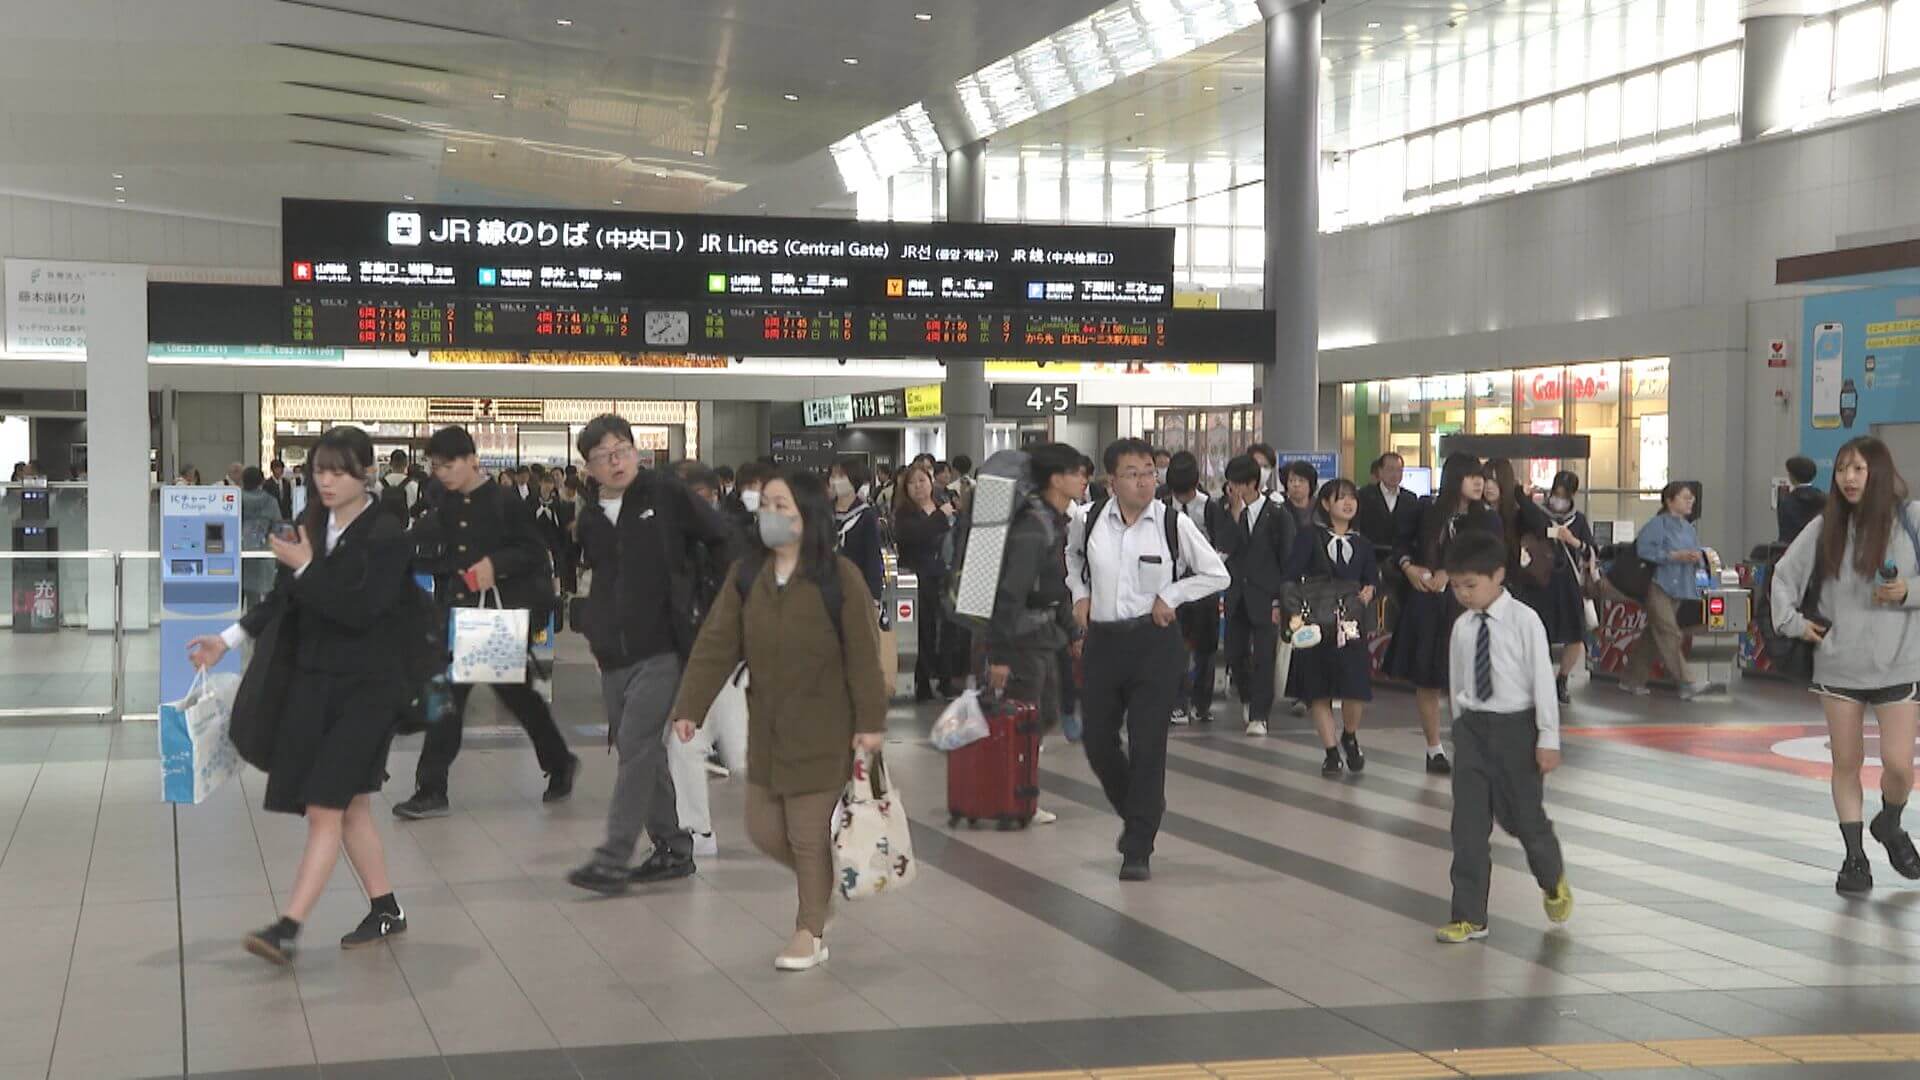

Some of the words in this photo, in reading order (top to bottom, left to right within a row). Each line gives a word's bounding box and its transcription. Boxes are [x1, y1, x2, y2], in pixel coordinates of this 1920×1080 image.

[429, 218, 471, 242] JR
[476, 219, 590, 247] 線のりば
[698, 235, 721, 254] JR
[728, 235, 778, 256] Lines
[784, 238, 845, 259] (Central
[848, 241, 889, 260] Gate)
[1011, 248, 1026, 263] JR
[379, 308, 406, 319] 7:44
[447, 309, 455, 320] 2
[556, 313, 580, 323] 7:41
[620, 314, 627, 324] 4
[379, 319, 406, 331] 7:50
[448, 321, 454, 332] 1
[620, 326, 628, 336] 2
[1003, 321, 1010, 332] 3
[448, 333, 454, 344] 1
[1003, 332, 1010, 343] 7
